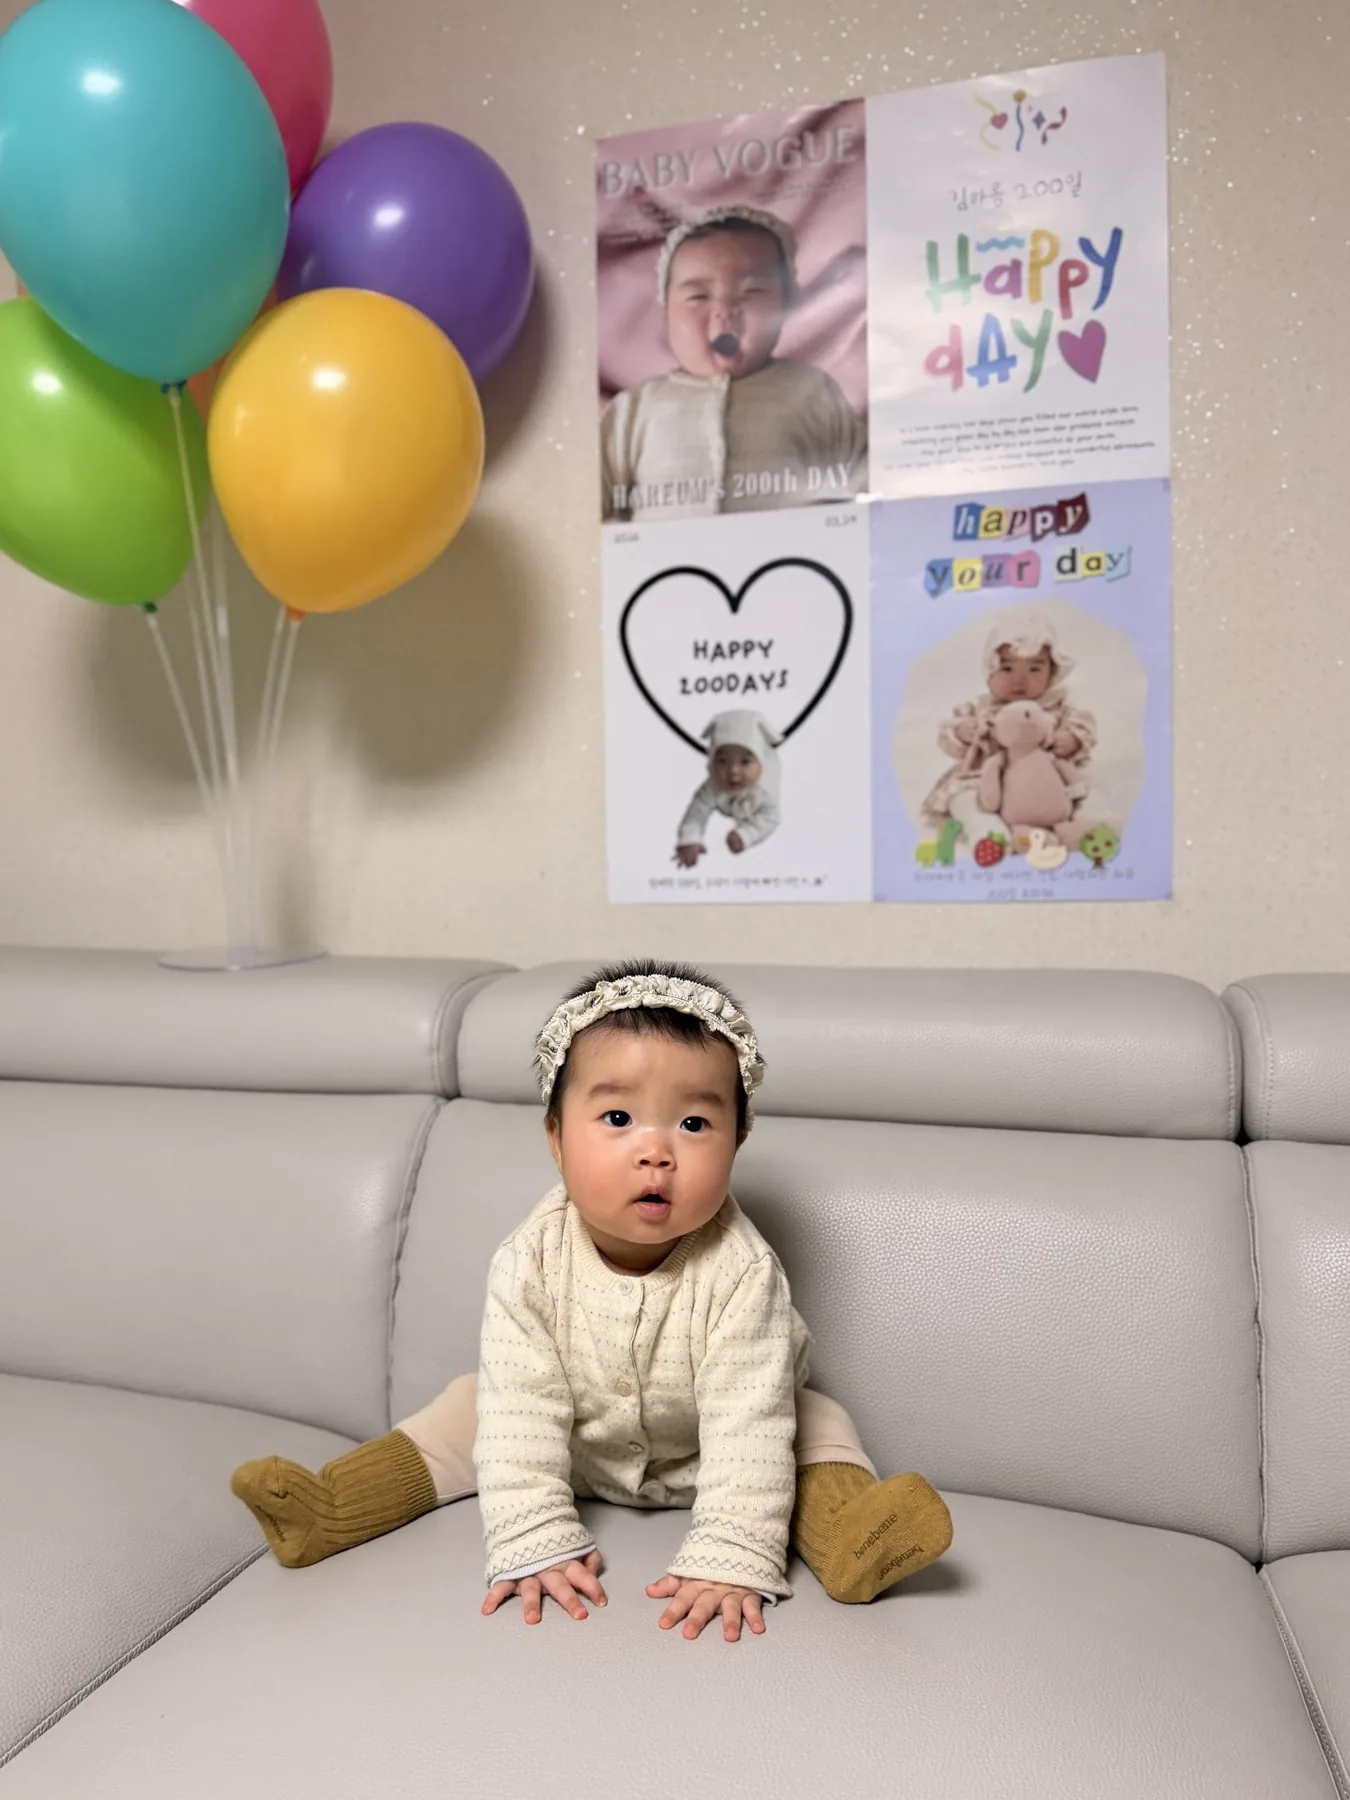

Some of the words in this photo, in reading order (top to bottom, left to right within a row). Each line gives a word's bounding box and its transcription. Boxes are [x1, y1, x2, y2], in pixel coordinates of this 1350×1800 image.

[603, 150, 698, 199] BABY
[713, 125, 858, 179] VOGUE
[1014, 170, 1083, 200] 200일
[732, 467, 798, 498] 200th
[807, 462, 851, 491] DAY
[955, 500, 1085, 538] happy
[927, 557, 1033, 593] your
[1056, 546, 1125, 576] day
[693, 638, 775, 663] HAPPY
[679, 668, 789, 696] 200DAYS
[853, 1513, 898, 1560] benebene
